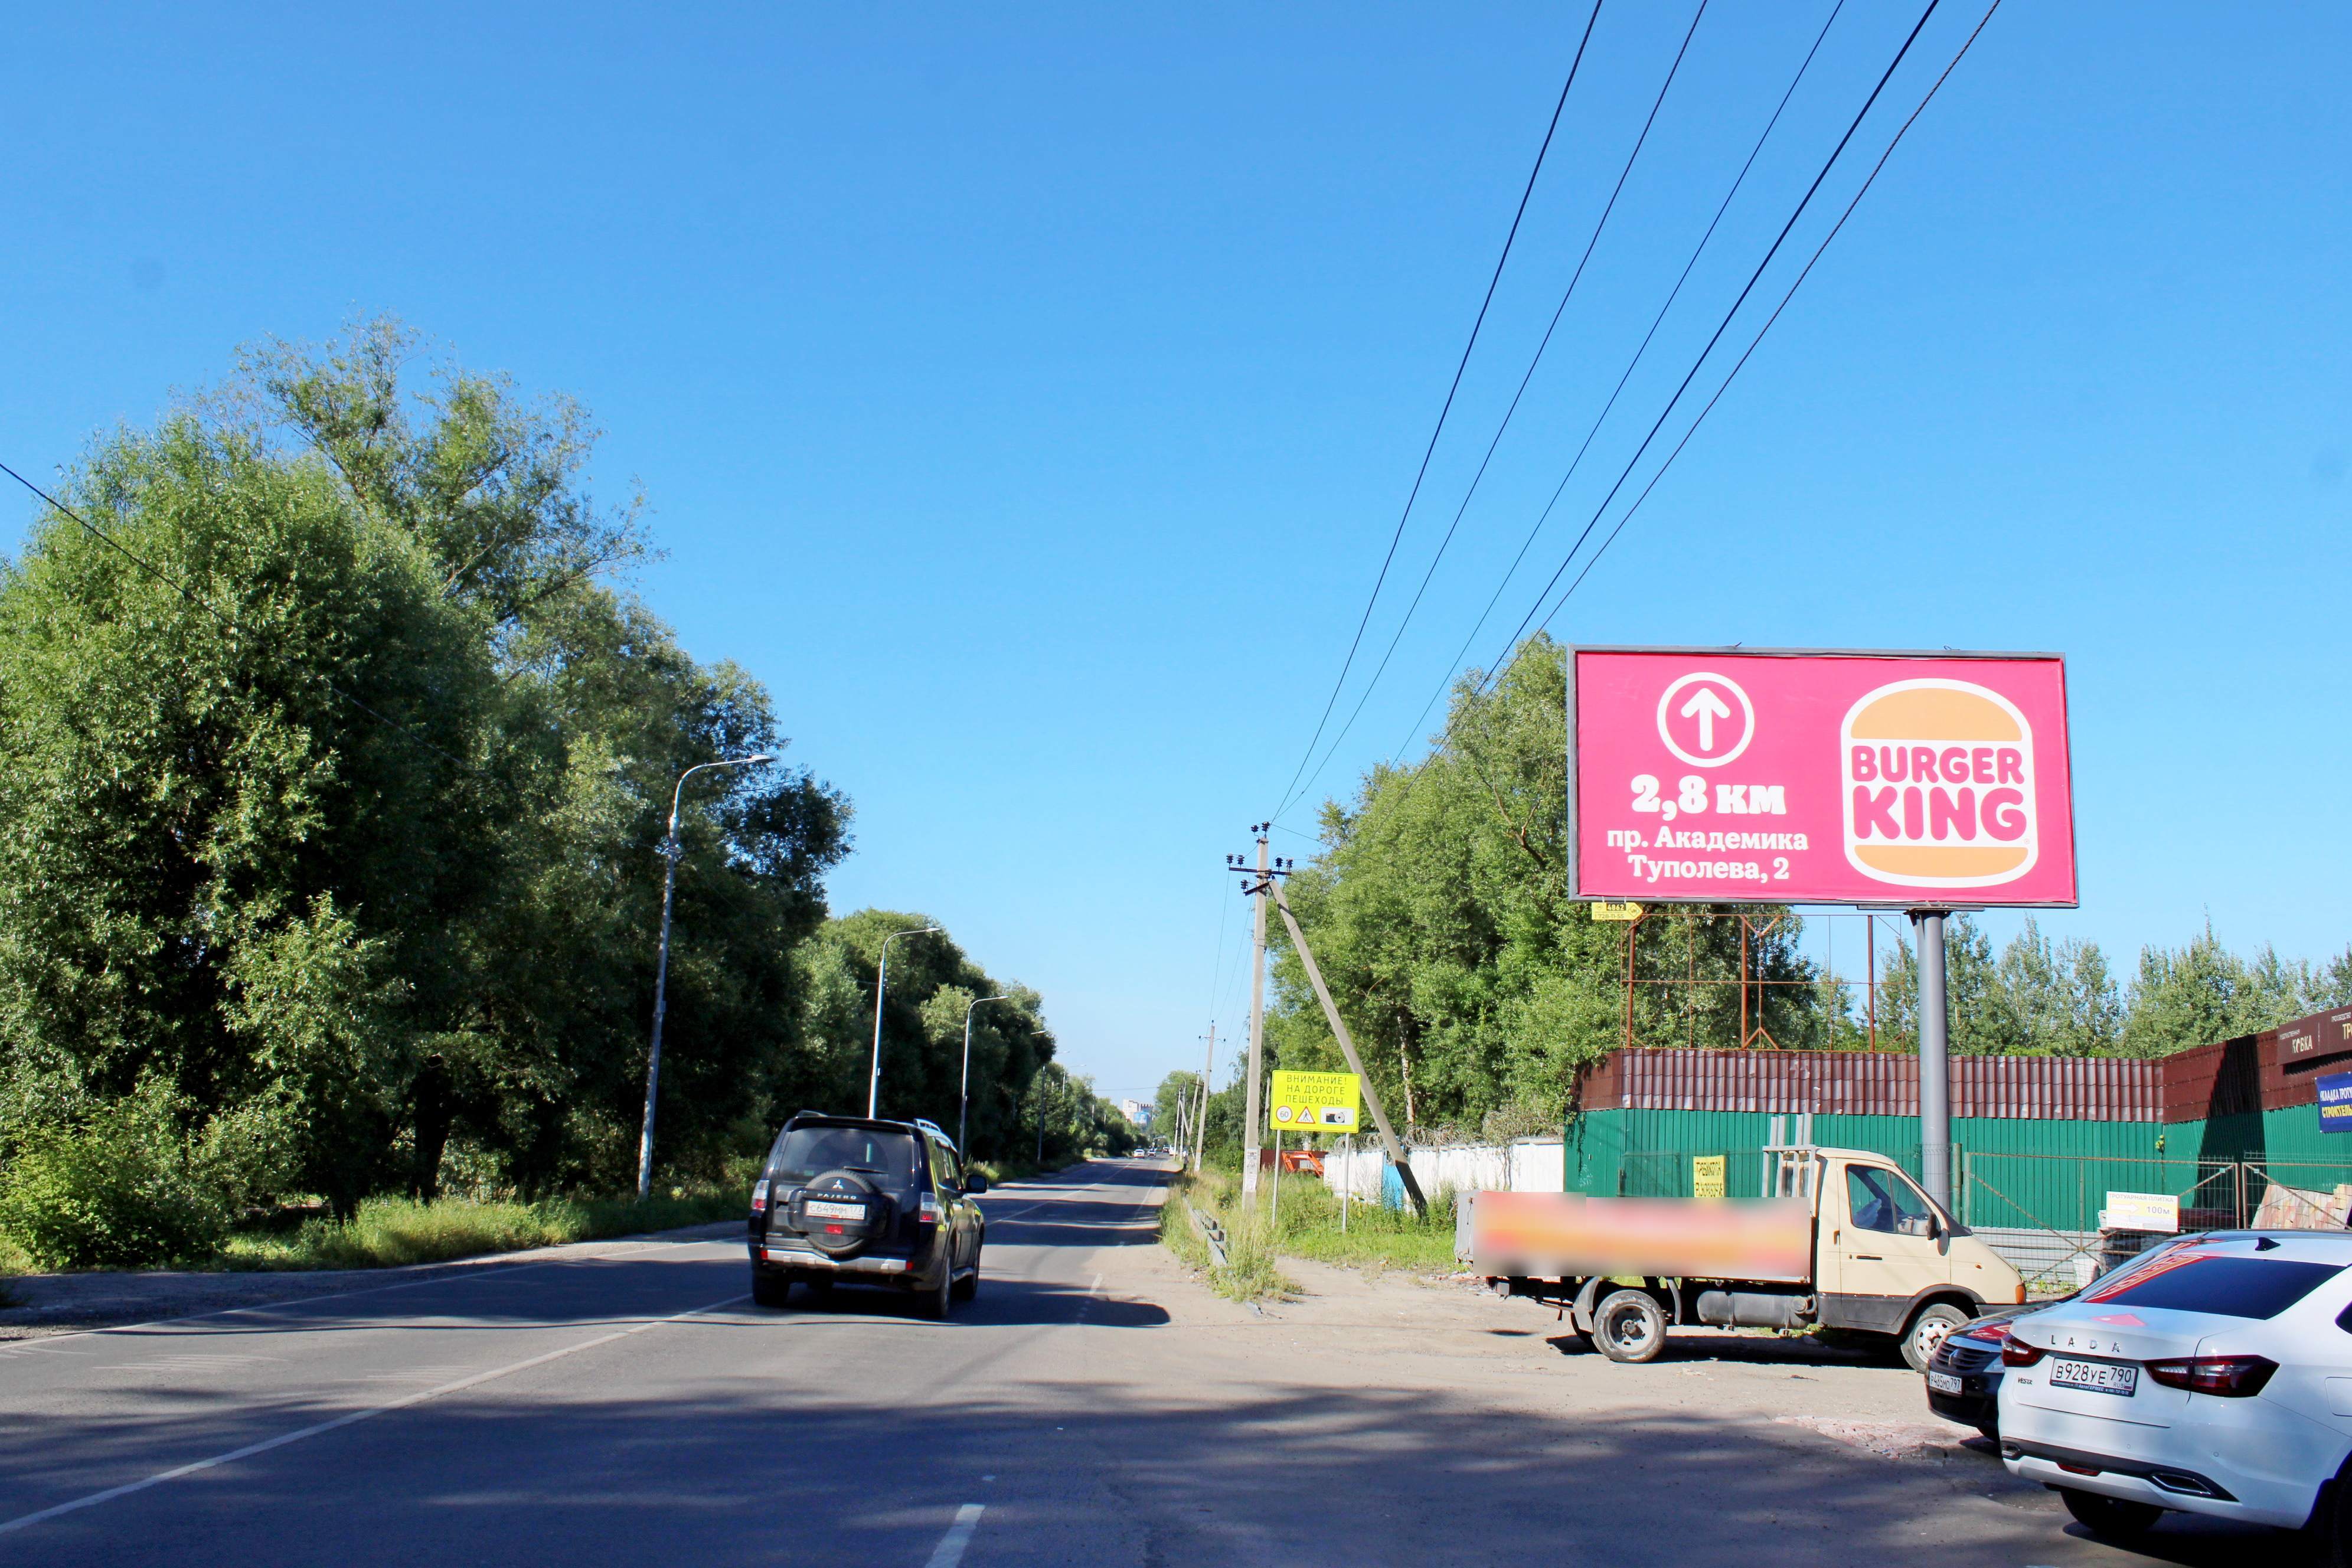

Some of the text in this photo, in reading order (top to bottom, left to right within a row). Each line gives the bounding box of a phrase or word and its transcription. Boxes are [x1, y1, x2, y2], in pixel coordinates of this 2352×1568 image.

[1852, 746, 2024, 783] BURGER
[1631, 775, 1786, 821] 2,8 км
[1854, 786, 2026, 841] KING
[1608, 826, 1808, 852] пр. Академика
[1628, 855, 1789, 883] Туполева, 2
[2343, 1023, 2352, 1040] ТР
[1287, 1074, 1347, 1084] ВНИМАНИЕ!
[1304, 1086, 1345, 1095] ДОРОГЕ
[1285, 1095, 1343, 1105] ПЕШЕХОДЫ
[2052, 1335, 2120, 1353] LADA
[2111, 1367, 2131, 1382] 790
